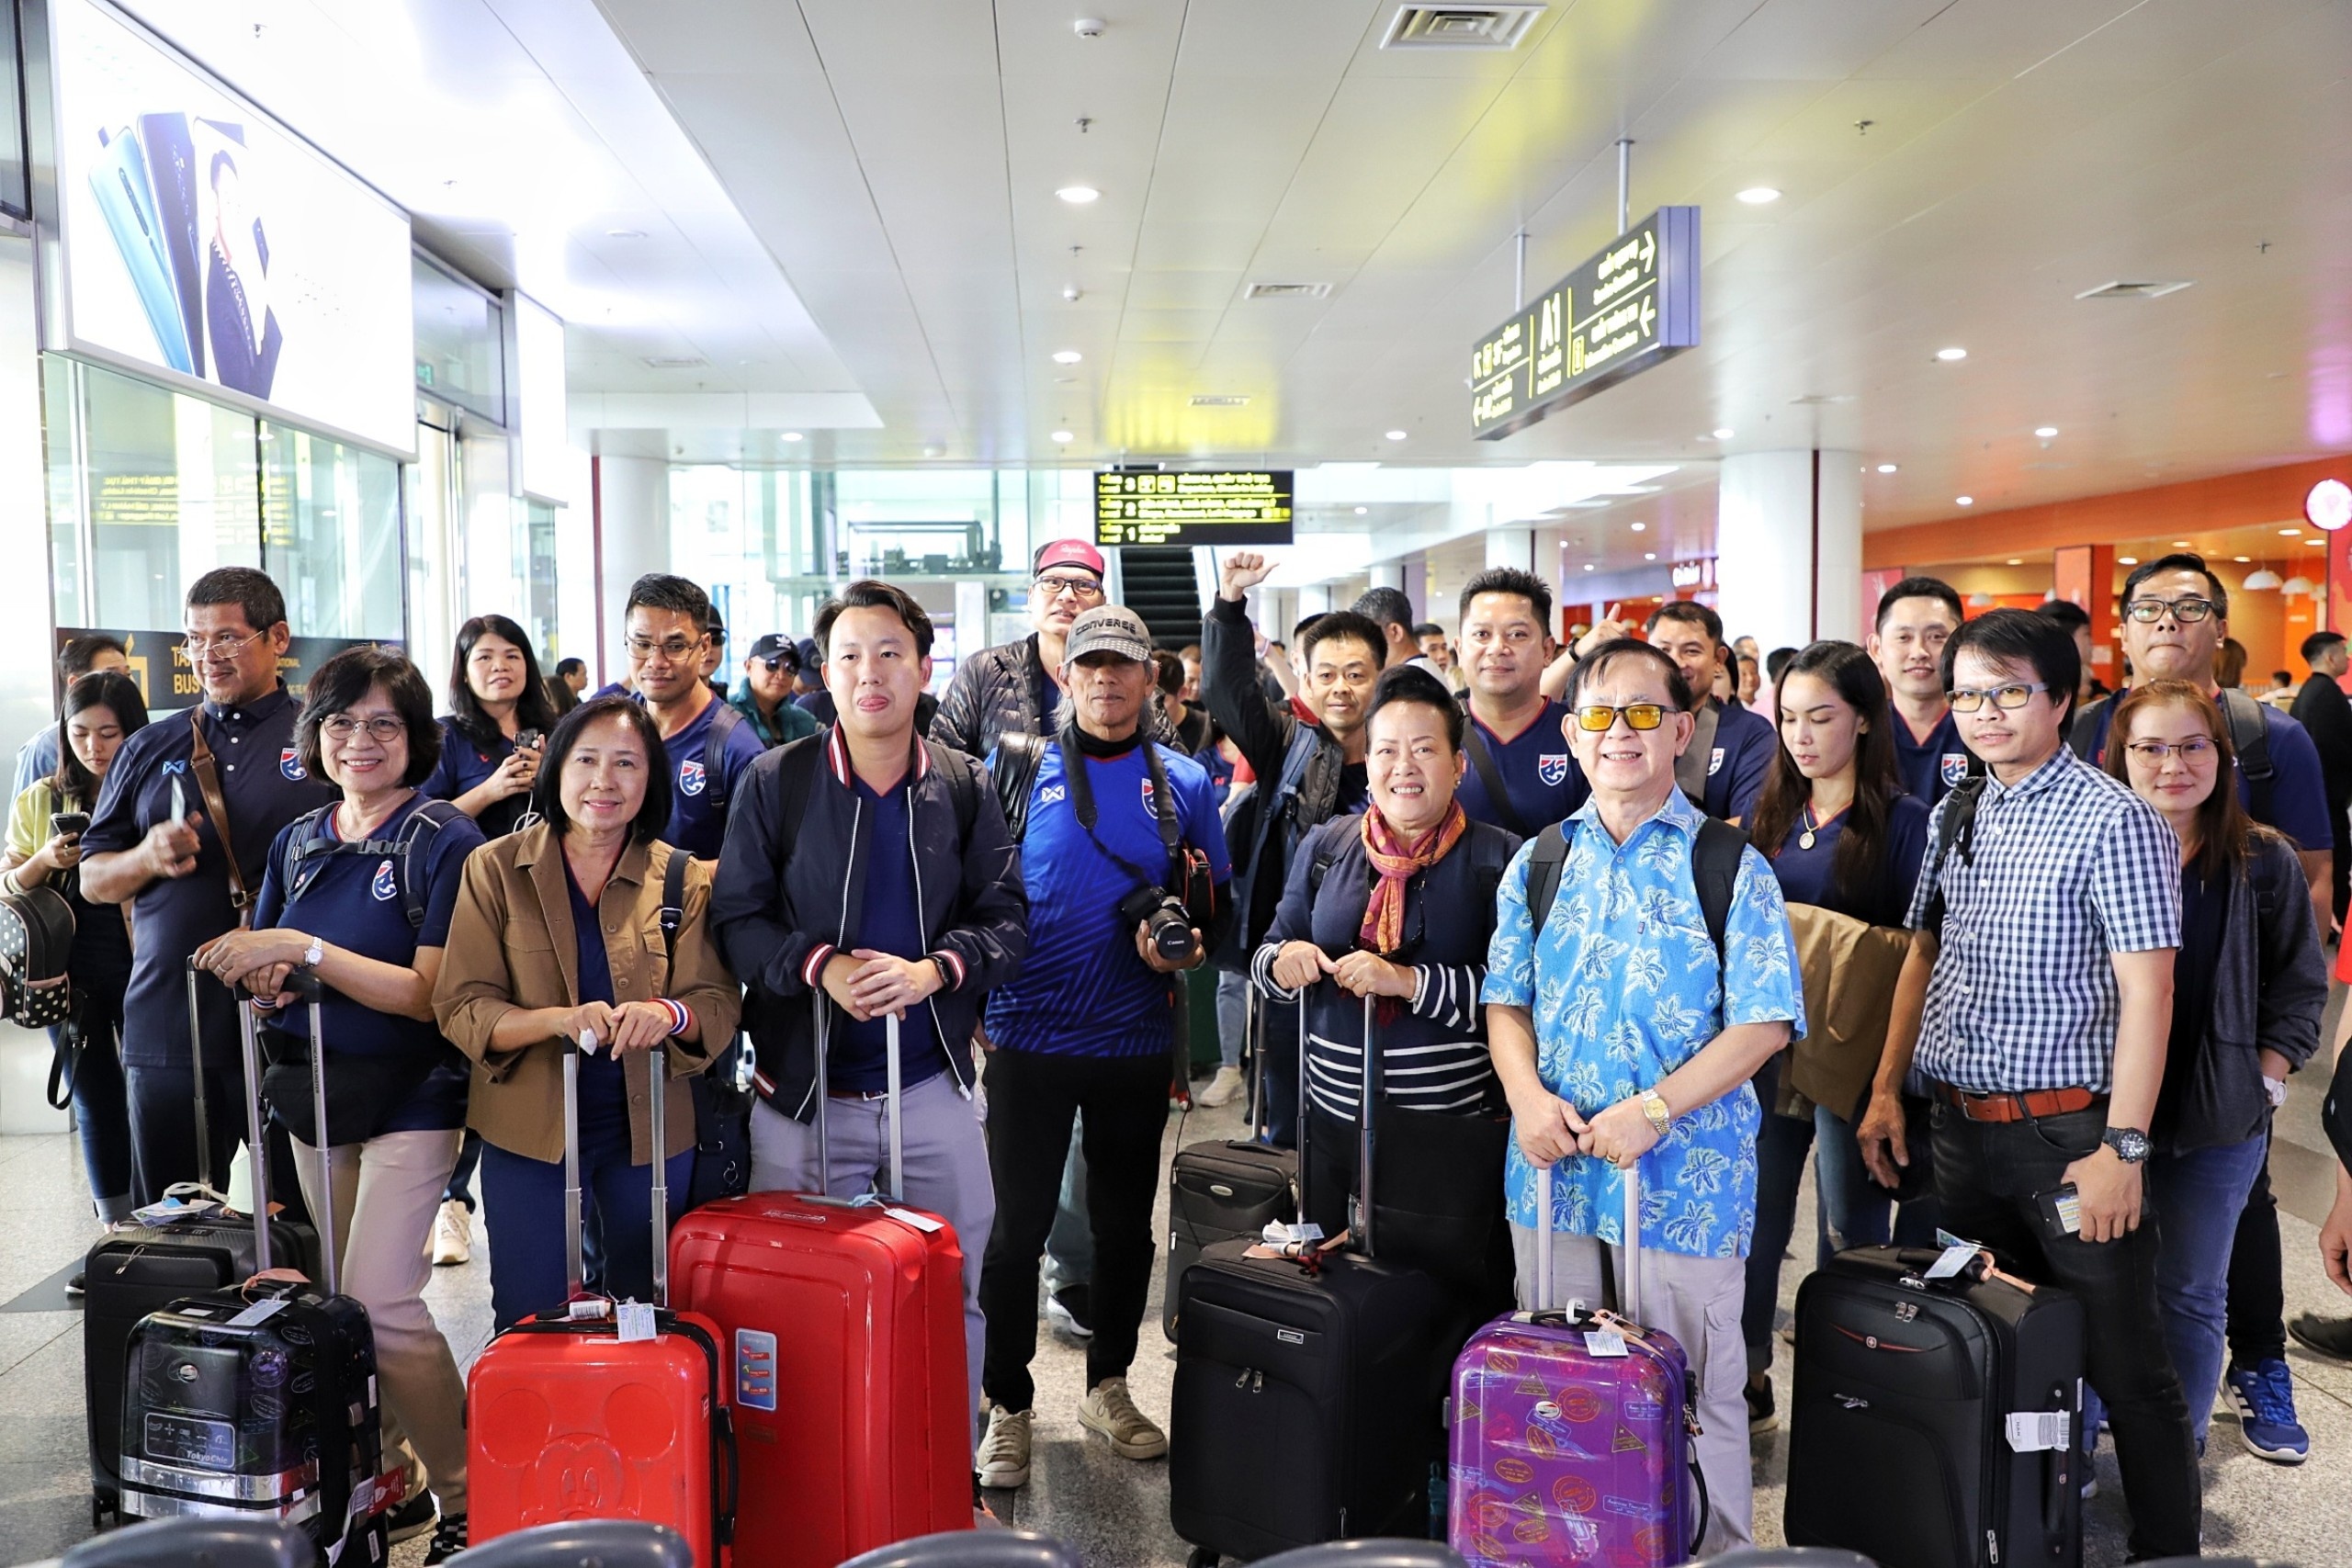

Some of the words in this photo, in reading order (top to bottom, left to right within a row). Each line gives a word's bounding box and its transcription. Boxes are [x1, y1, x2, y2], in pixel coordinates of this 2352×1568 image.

[1540, 292, 1561, 352] A1
[1126, 526, 1136, 541] 1
[1075, 618, 1137, 636] CONVERSE
[174, 674, 200, 694] BUS
